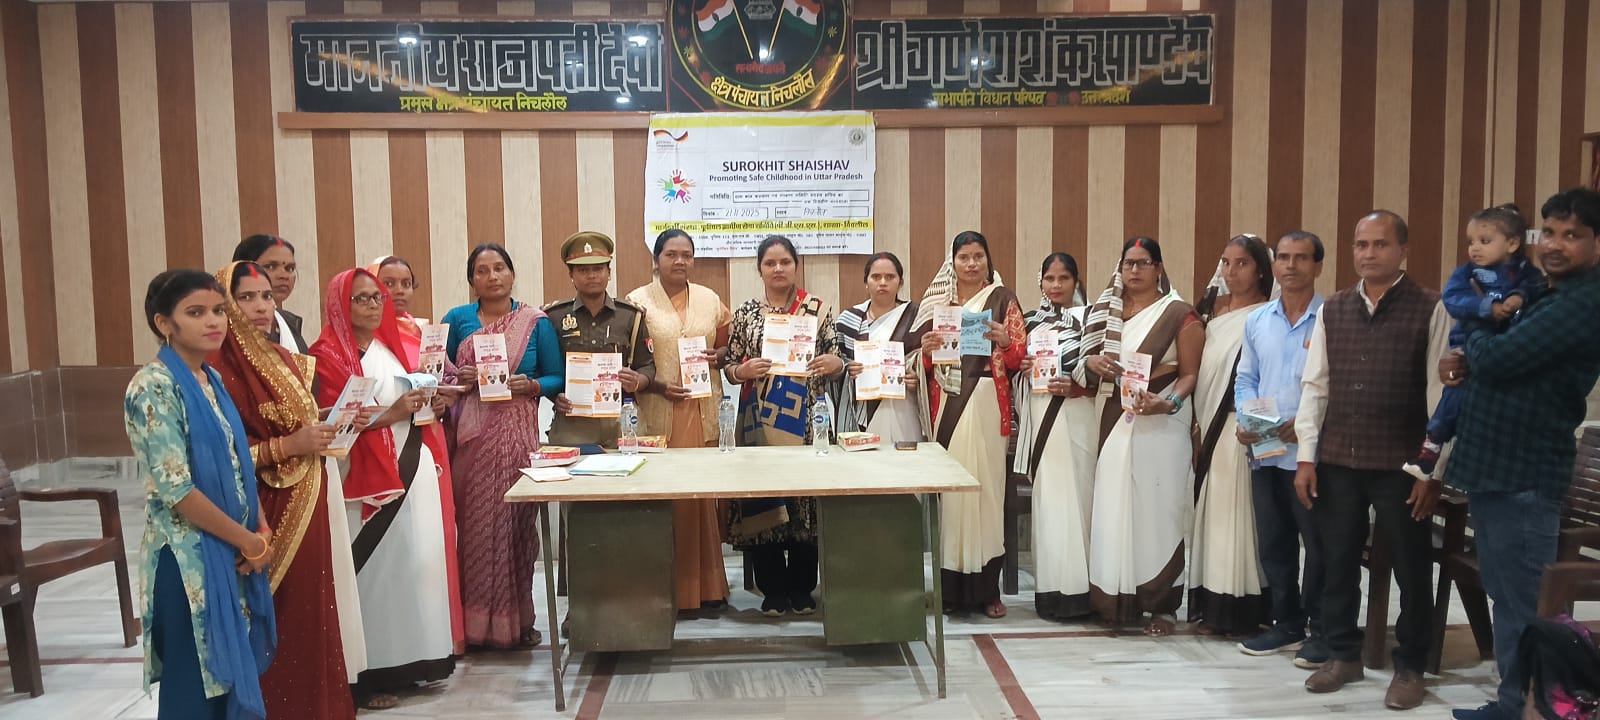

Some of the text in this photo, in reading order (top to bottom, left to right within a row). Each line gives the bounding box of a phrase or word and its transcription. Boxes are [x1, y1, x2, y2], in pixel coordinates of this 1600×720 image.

[710, 76, 731, 99] क्षेत्र
[722, 159, 850, 172] SUROKHIT SHAISHAV
[709, 172, 863, 183] Promoting Safe Childhood in Uttar Pradesh
